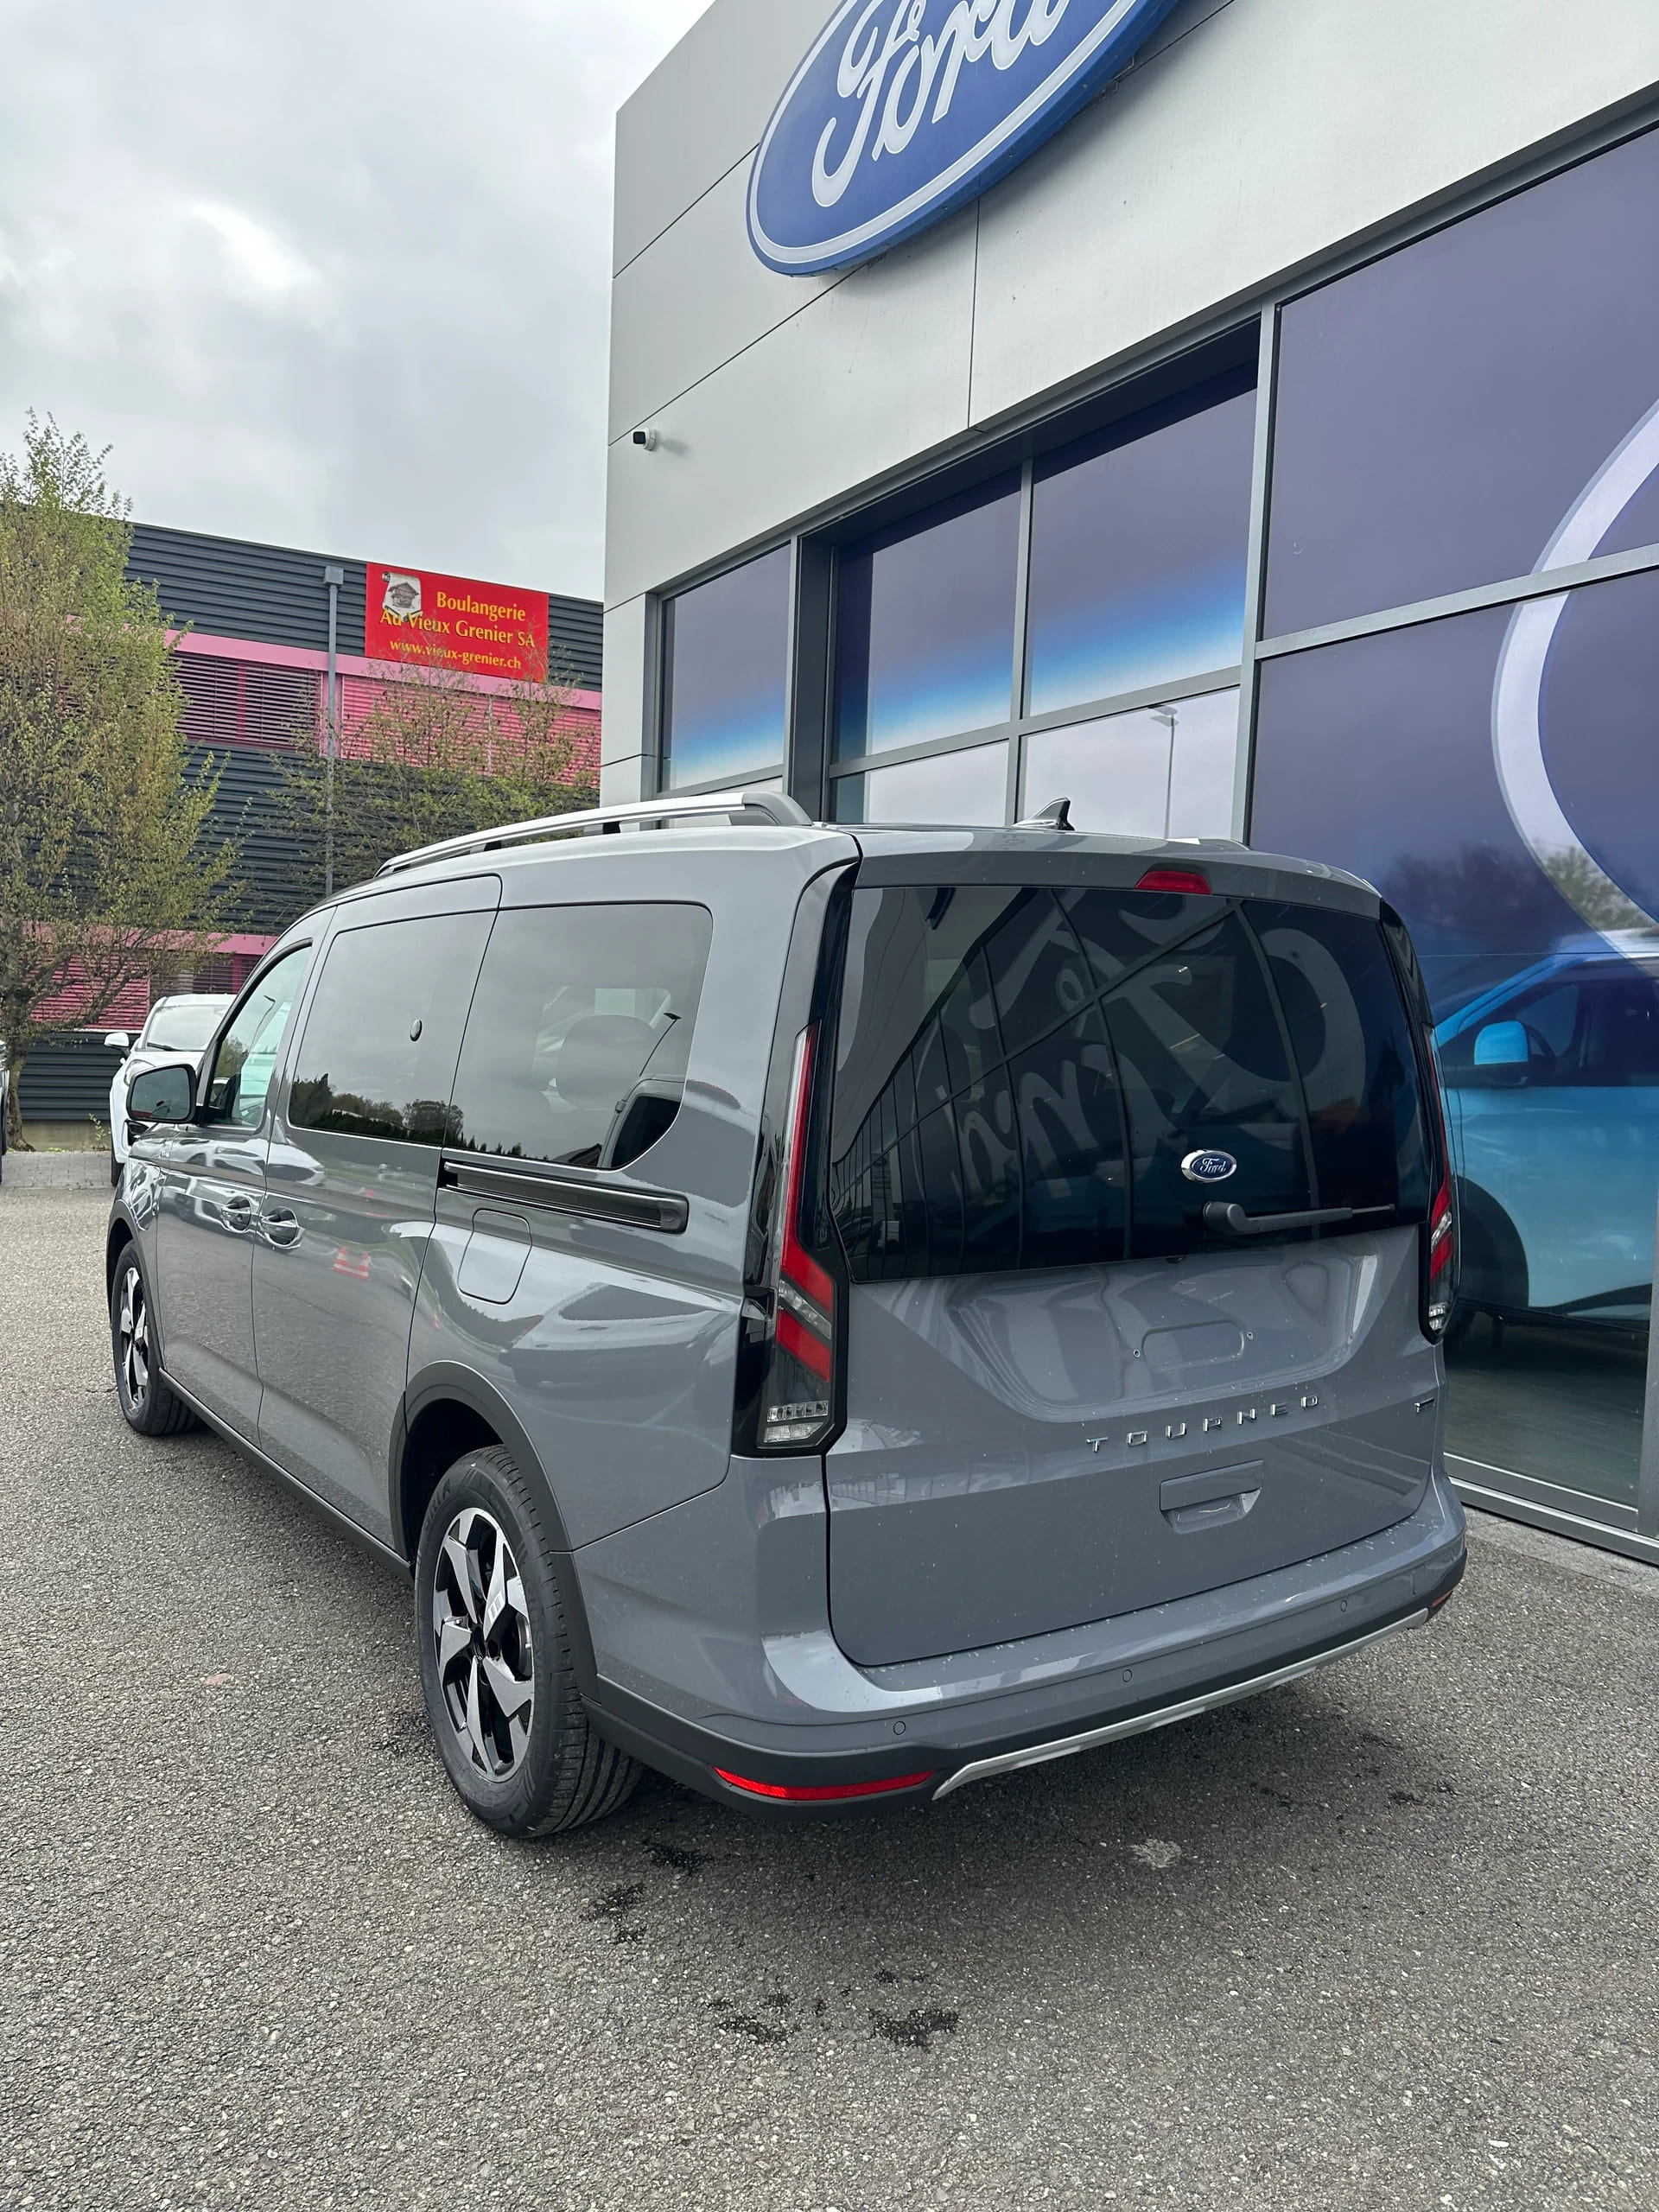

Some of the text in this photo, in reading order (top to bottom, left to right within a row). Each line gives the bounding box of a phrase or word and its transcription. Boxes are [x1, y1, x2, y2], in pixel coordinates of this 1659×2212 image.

[436, 591, 526, 621] Boulangerie
[380, 608, 536, 648] Au Vieux Grenier SA
[1199, 1157, 1227, 1173] Ford
